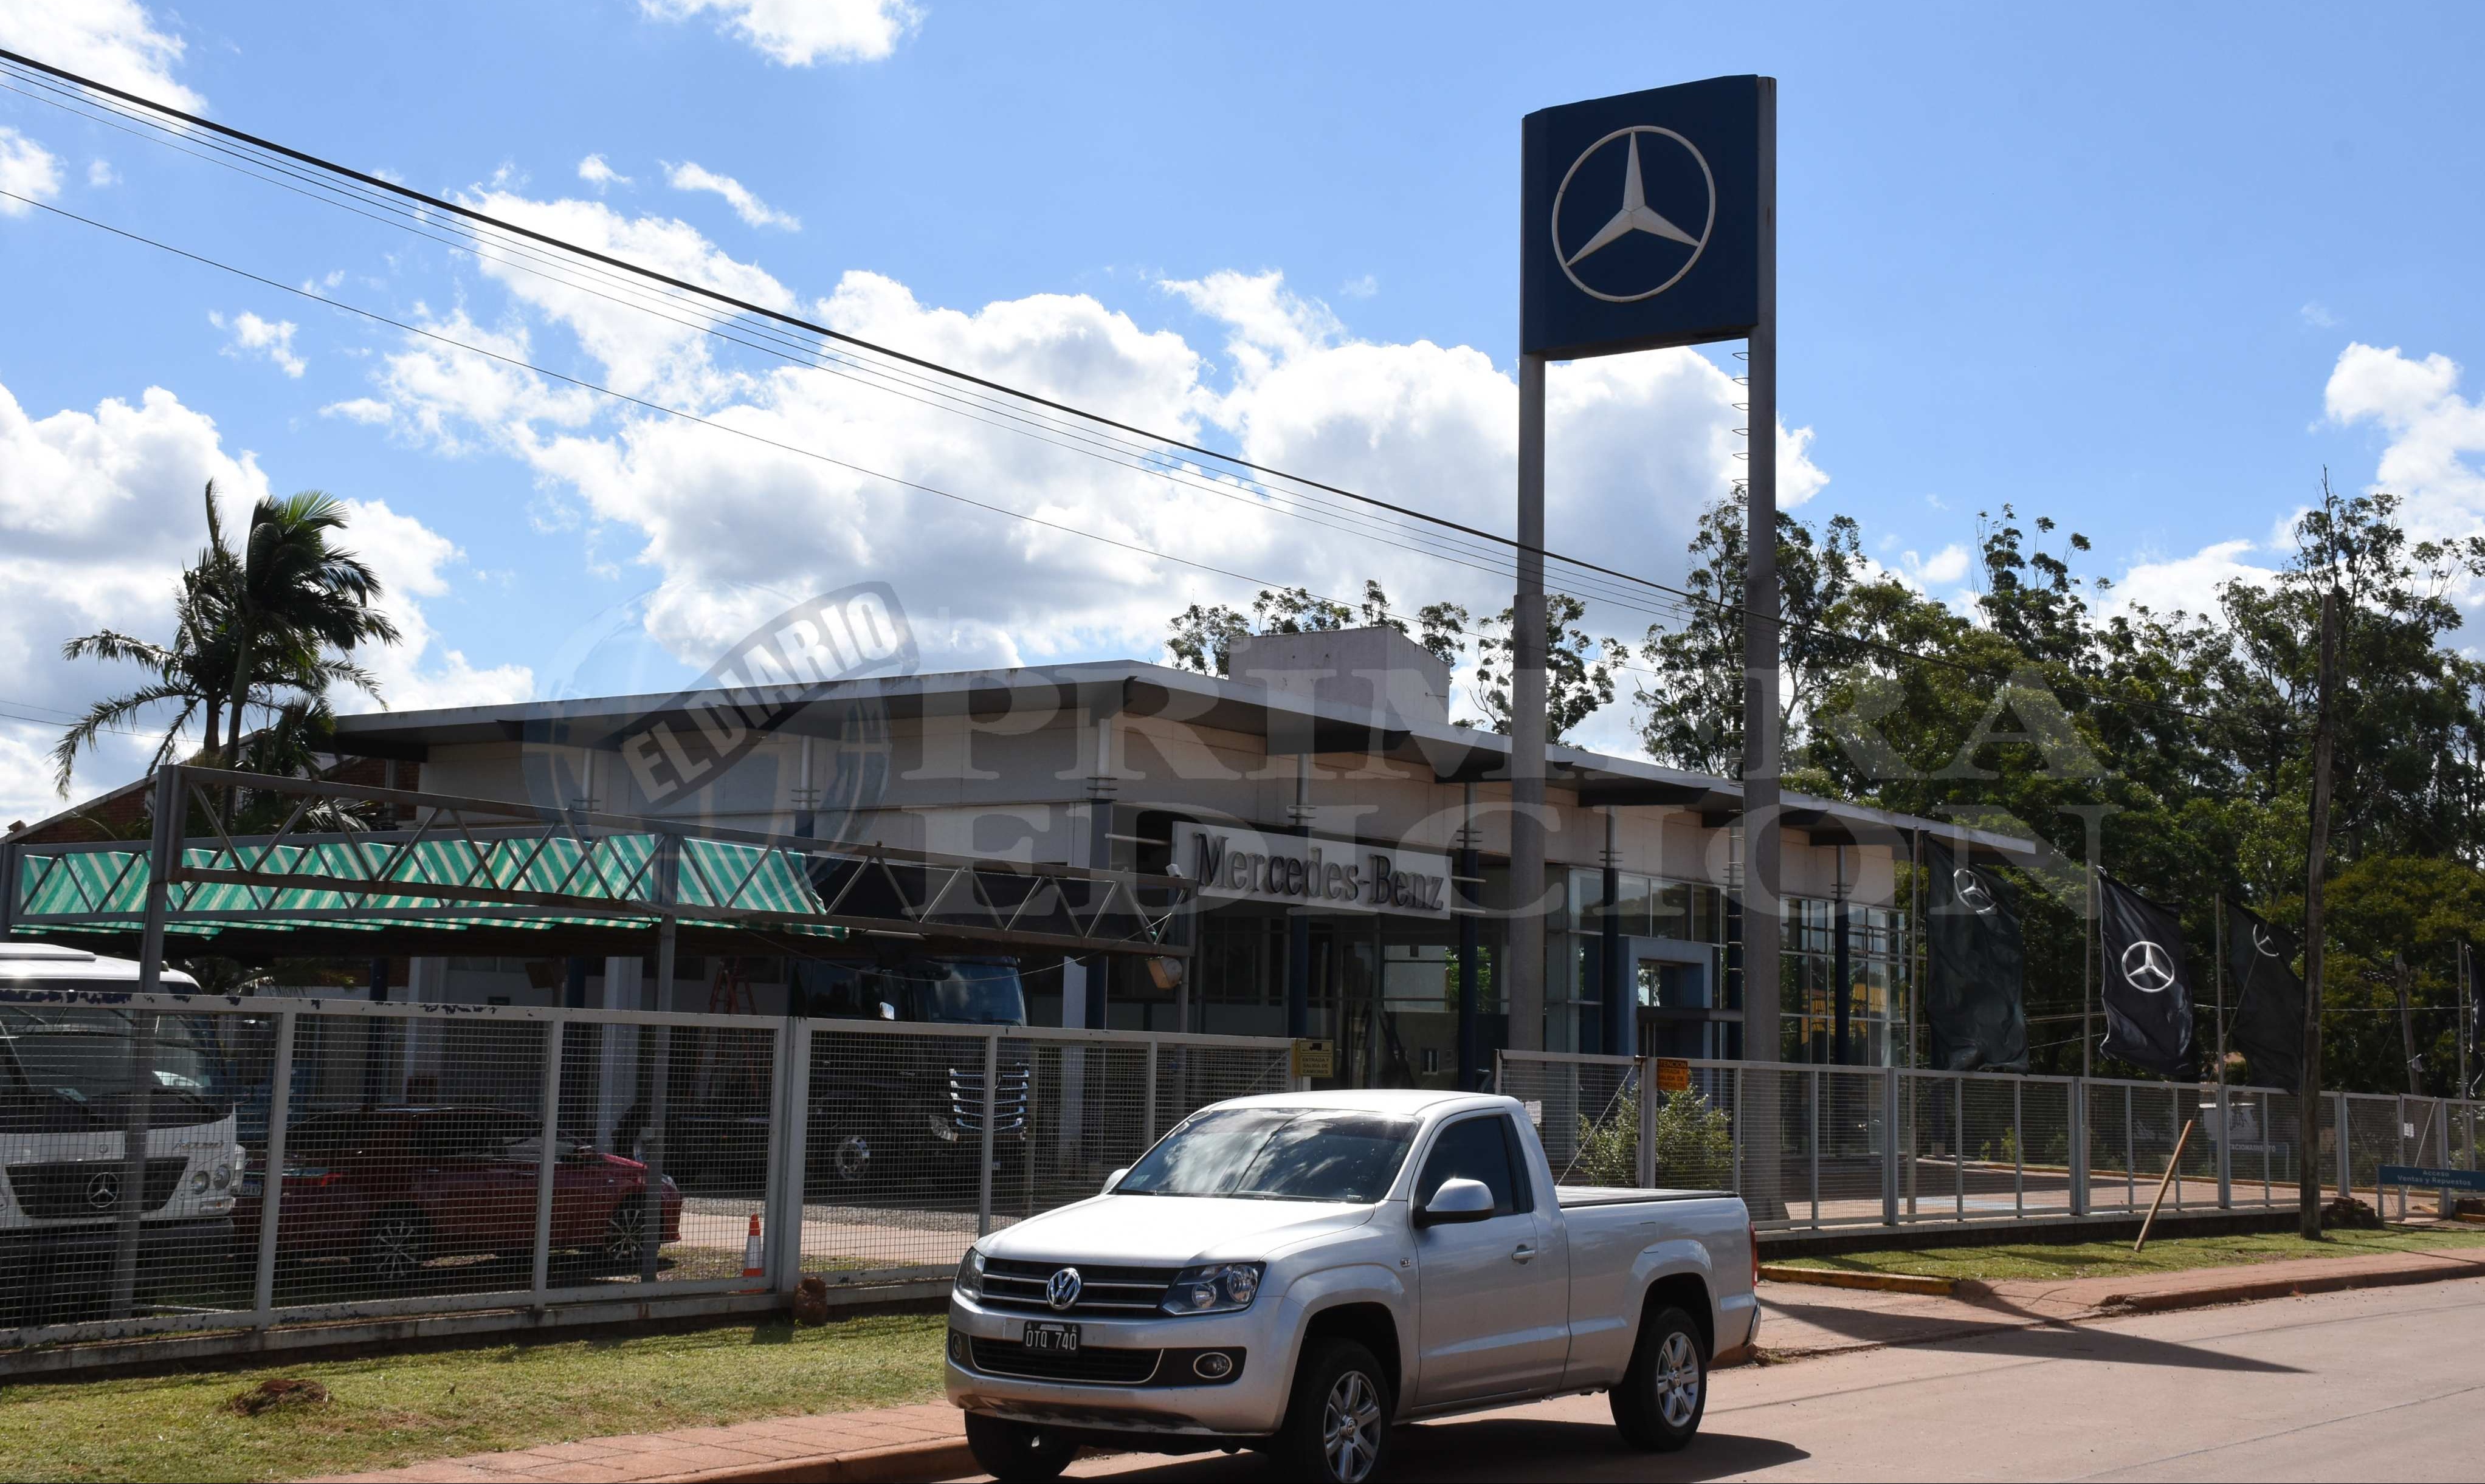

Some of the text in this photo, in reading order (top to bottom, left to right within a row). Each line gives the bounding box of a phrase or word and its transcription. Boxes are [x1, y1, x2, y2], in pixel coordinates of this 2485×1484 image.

[1193, 831, 1444, 911] Mercedes-Benz
[2397, 1174, 2423, 1183] Ventas
[2432, 1177, 2472, 1186] Repuestos
[1055, 1332, 1077, 1351] 740
